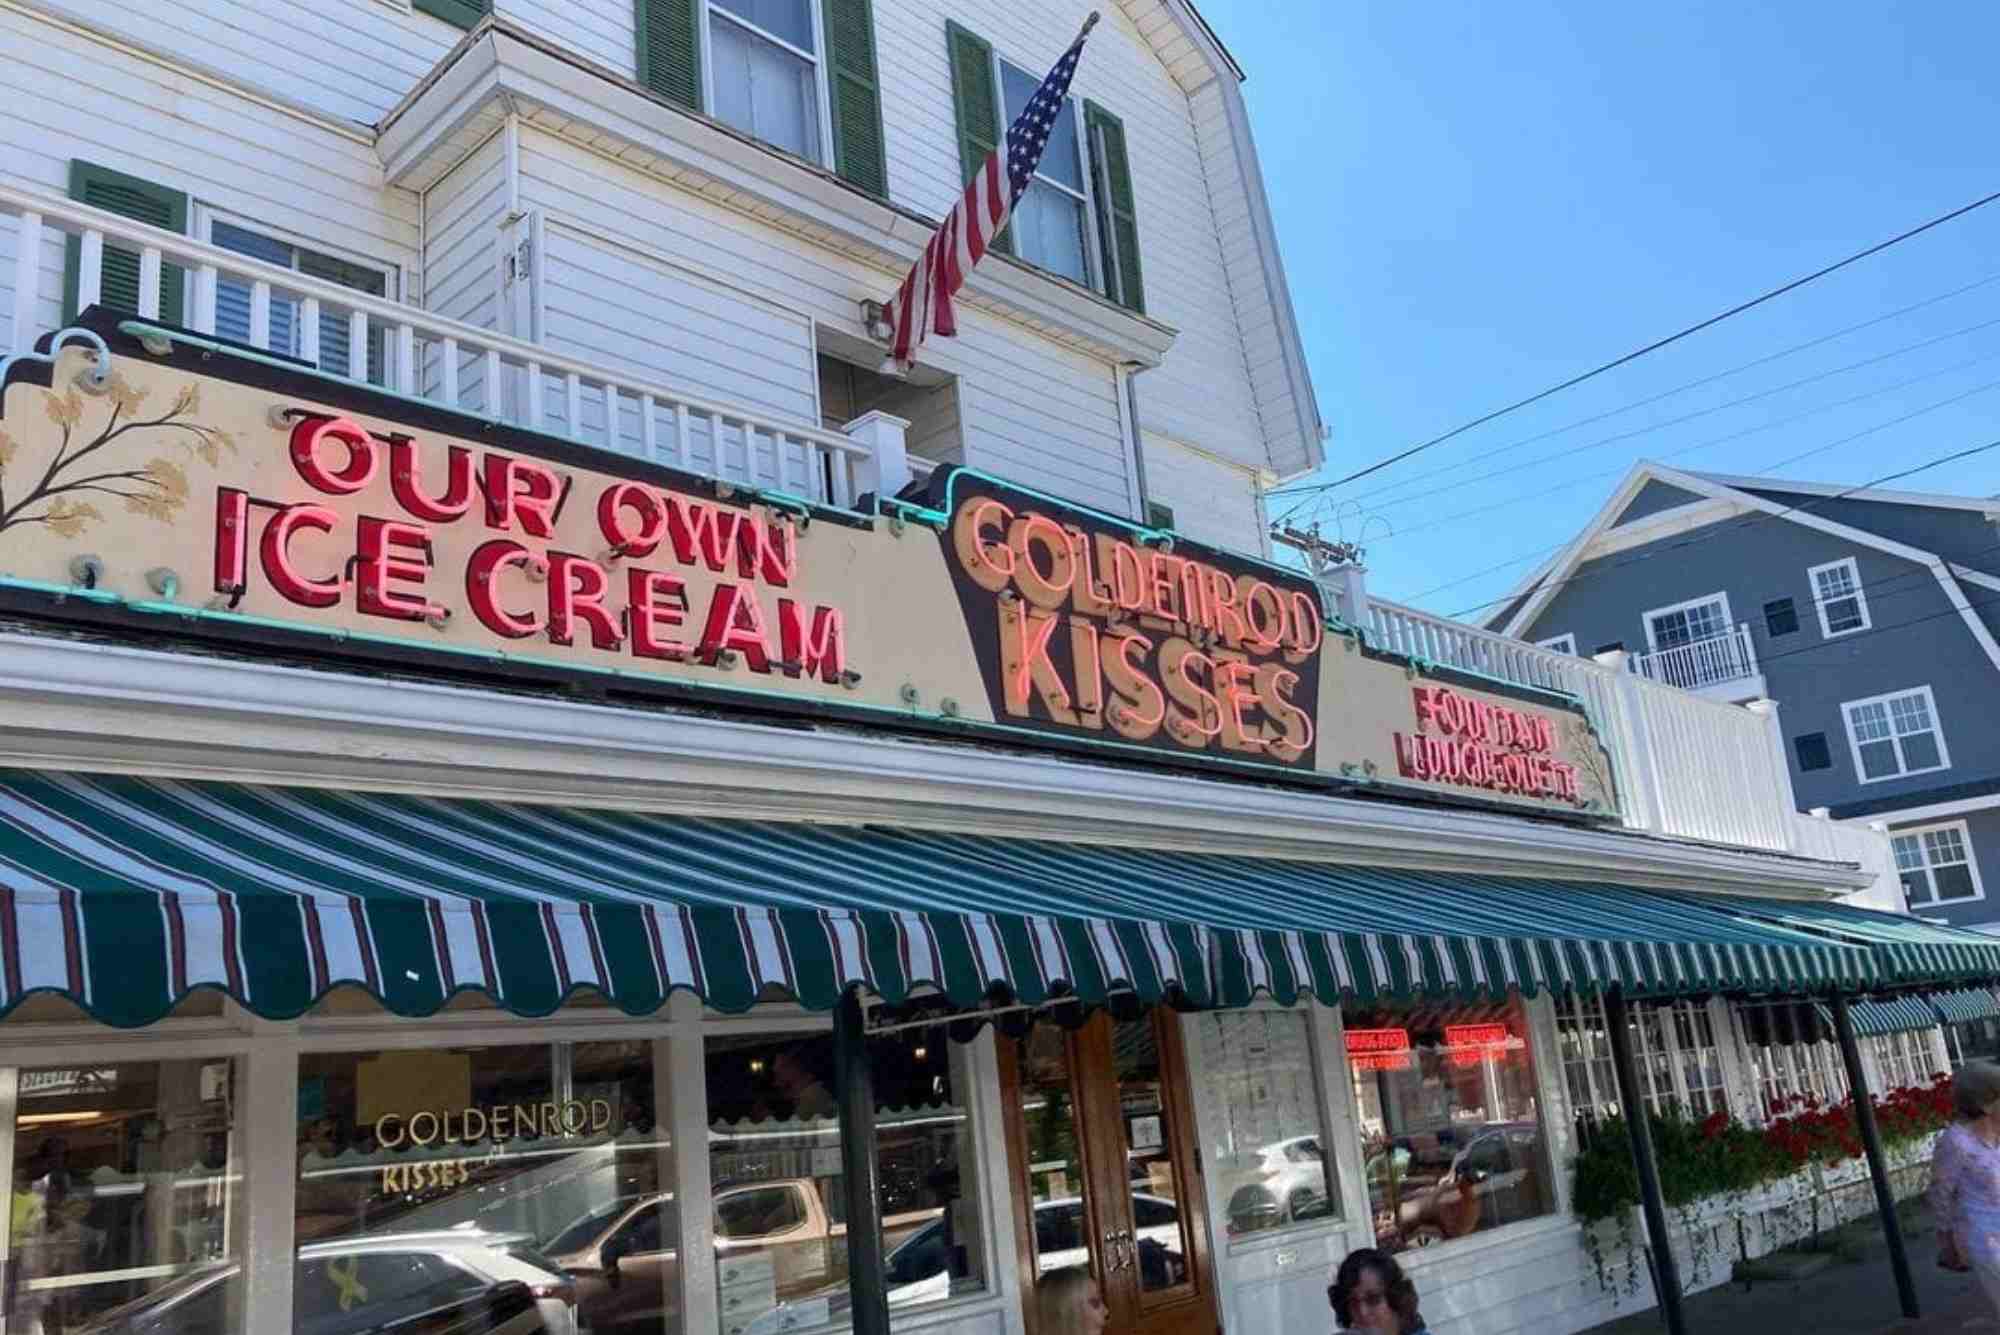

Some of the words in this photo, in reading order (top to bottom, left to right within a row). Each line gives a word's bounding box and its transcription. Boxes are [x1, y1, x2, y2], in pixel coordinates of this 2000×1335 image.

[290, 416, 559, 539] OUR
[598, 481, 797, 587] OWN
[953, 496, 1321, 664] GOLDENROD
[214, 486, 434, 621] ICE
[466, 539, 846, 684] CREAM
[998, 598, 1313, 762] KISSES
[376, 1100, 611, 1148] GOLDENROD
[383, 1159, 469, 1193] KISSES
